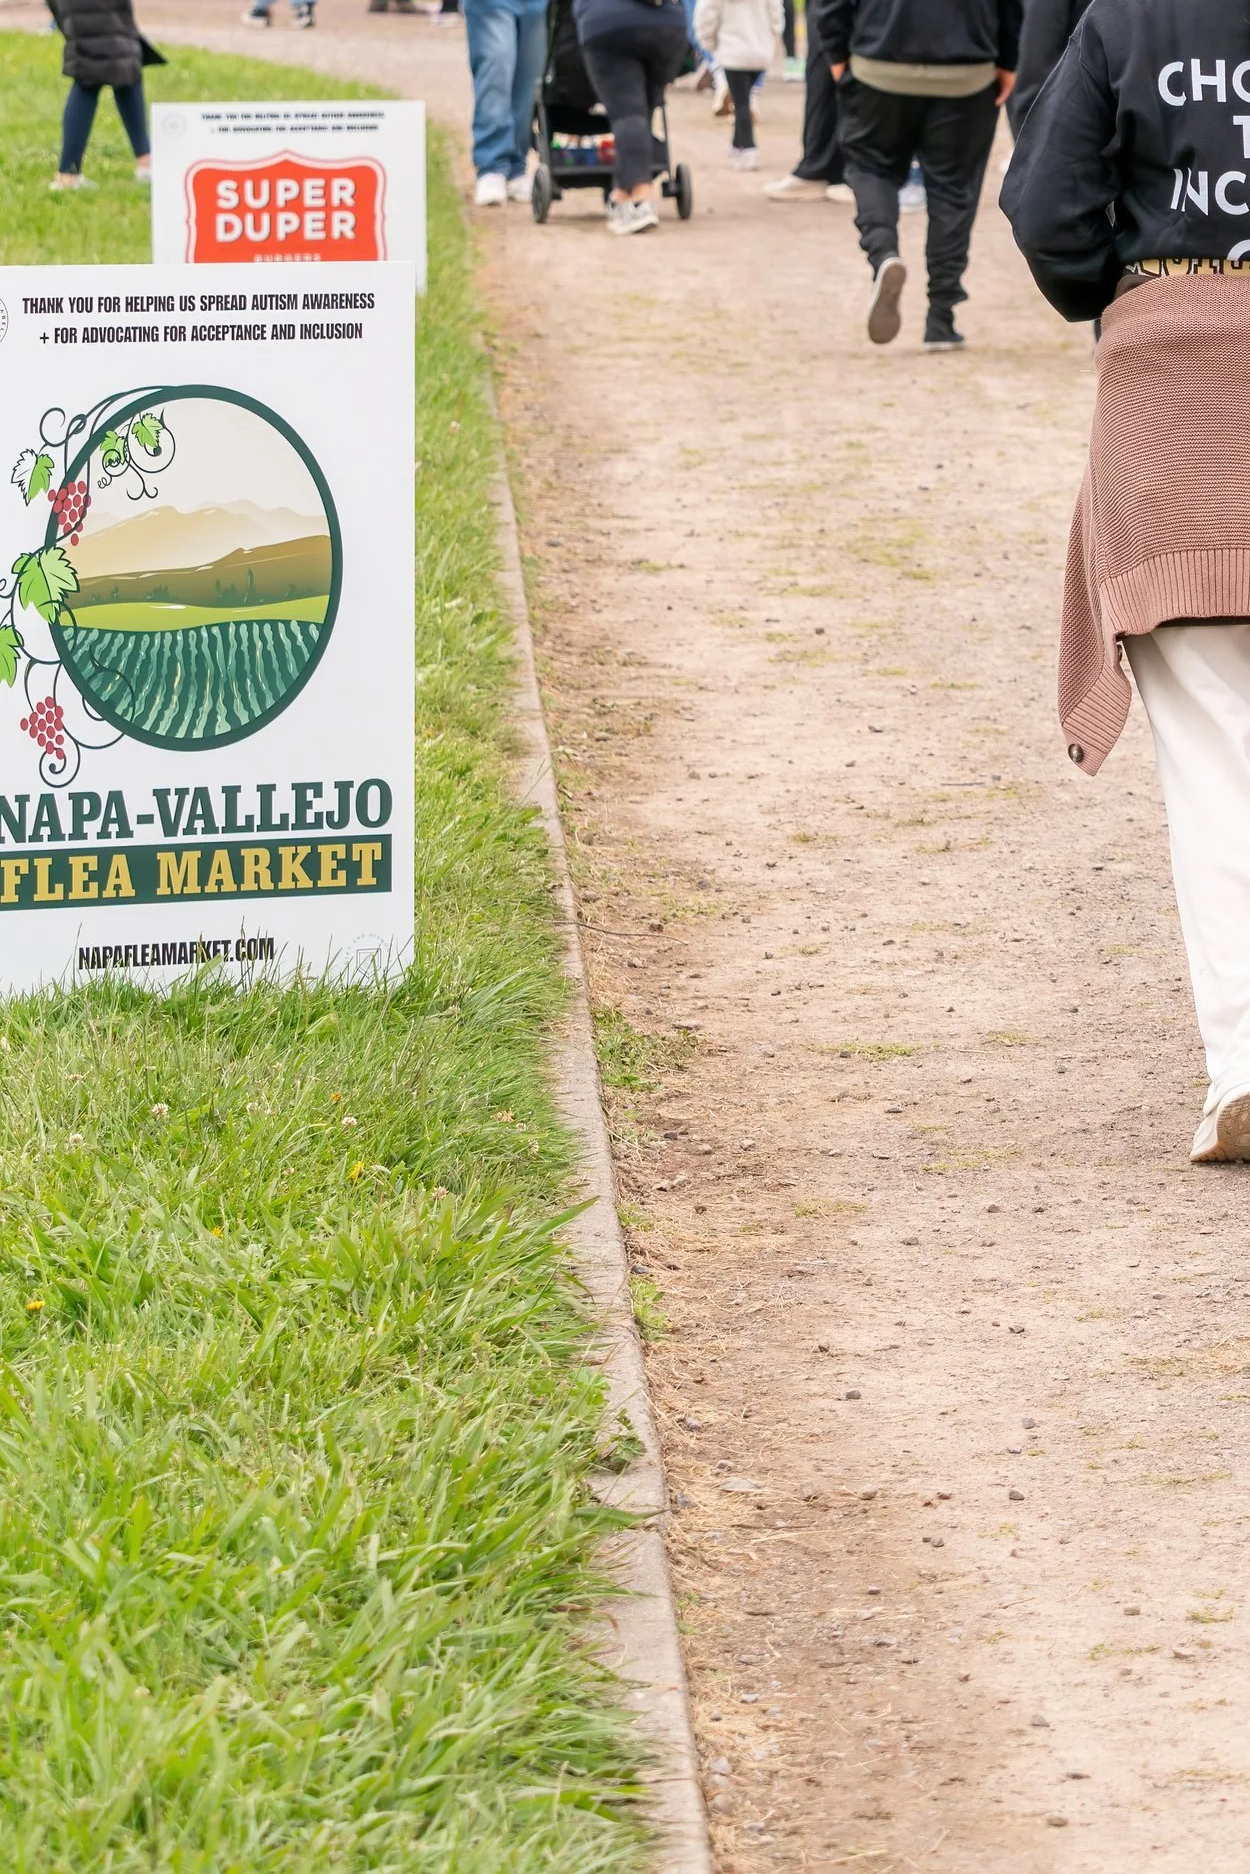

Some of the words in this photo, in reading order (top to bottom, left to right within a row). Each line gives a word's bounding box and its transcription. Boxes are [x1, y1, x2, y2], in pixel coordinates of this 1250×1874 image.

[216, 178, 356, 209] SUPER
[215, 211, 356, 243] DUPER
[22, 297, 64, 314] THANK
[68, 297, 93, 314] YOU
[97, 296, 121, 313] FOR
[125, 295, 175, 313] HELPING
[179, 295, 196, 312] US
[200, 294, 247, 312] SPREAD
[251, 294, 298, 311] AUTISM
[302, 292, 375, 310] AWARENESS
[39, 332, 50, 344] +
[54, 327, 78, 344] FOR
[82, 326, 159, 343] ADVOCATING
[163, 325, 187, 342] FOR
[191, 324, 267, 341] ACCEPTANCE
[271, 323, 296, 340] AND
[300, 322, 363, 340] INCLUSION
[0, 778, 393, 844] NAPA-VALLEJO
[0, 854, 136, 904] FLEA
[156, 842, 382, 896] MARKET
[78, 937, 275, 971] NAPAFLEAMARKET.COM
